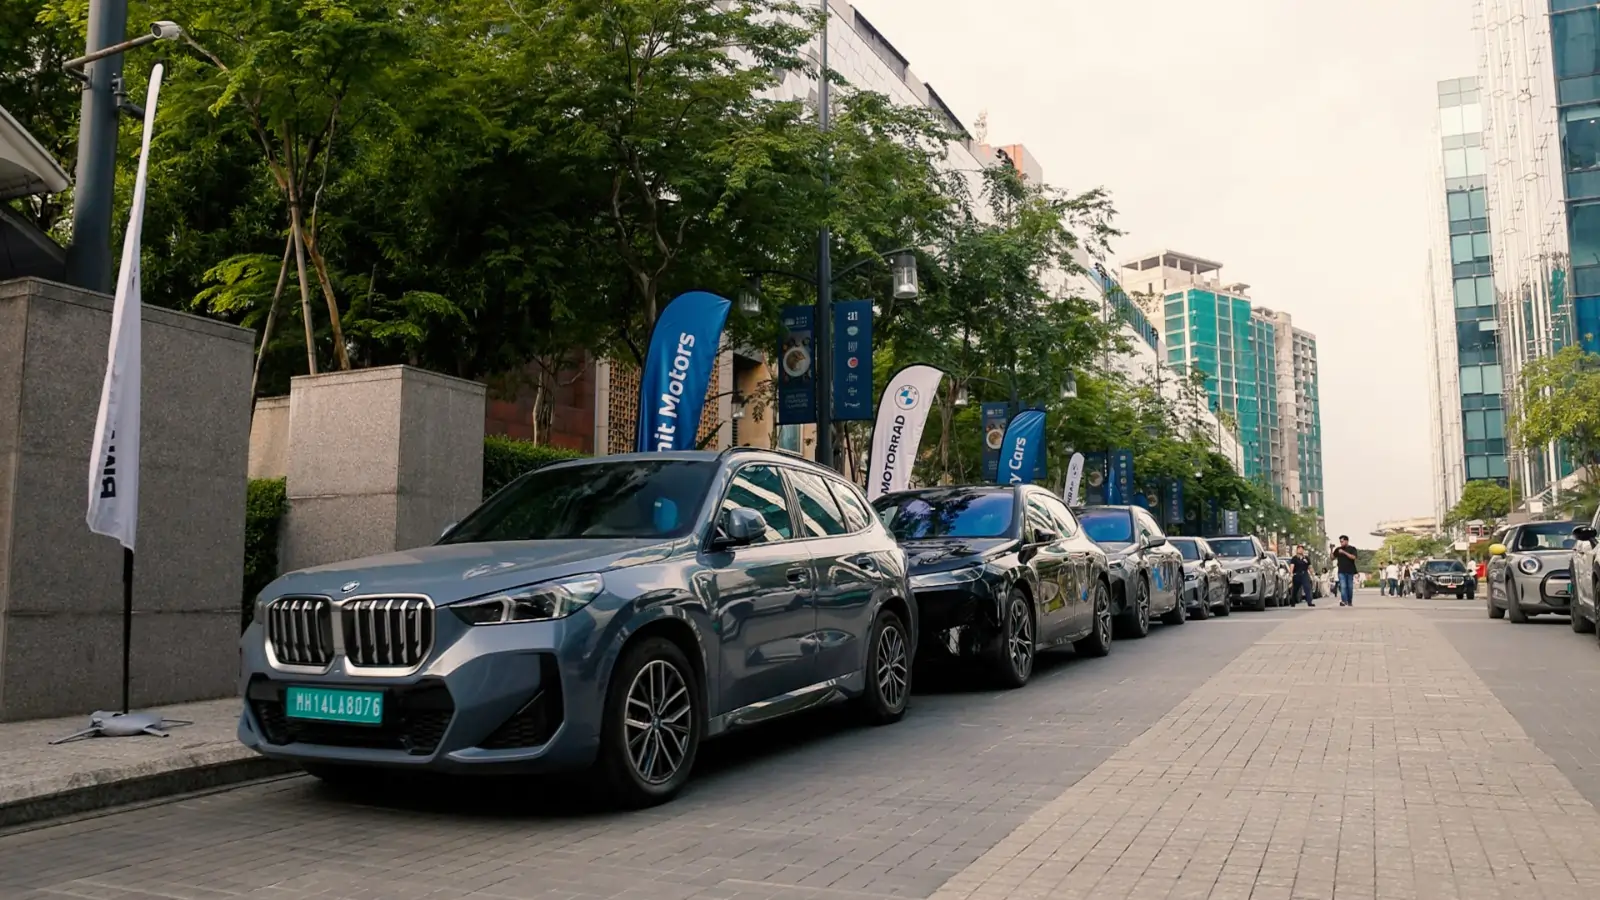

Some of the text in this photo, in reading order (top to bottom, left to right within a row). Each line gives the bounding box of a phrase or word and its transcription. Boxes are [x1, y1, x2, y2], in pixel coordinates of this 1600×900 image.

[658, 332, 695, 418] Motors
[881, 415, 905, 494] MOTORRAD
[1009, 437, 1027, 470] Cars
[296, 692, 380, 717] MH14LA8076
